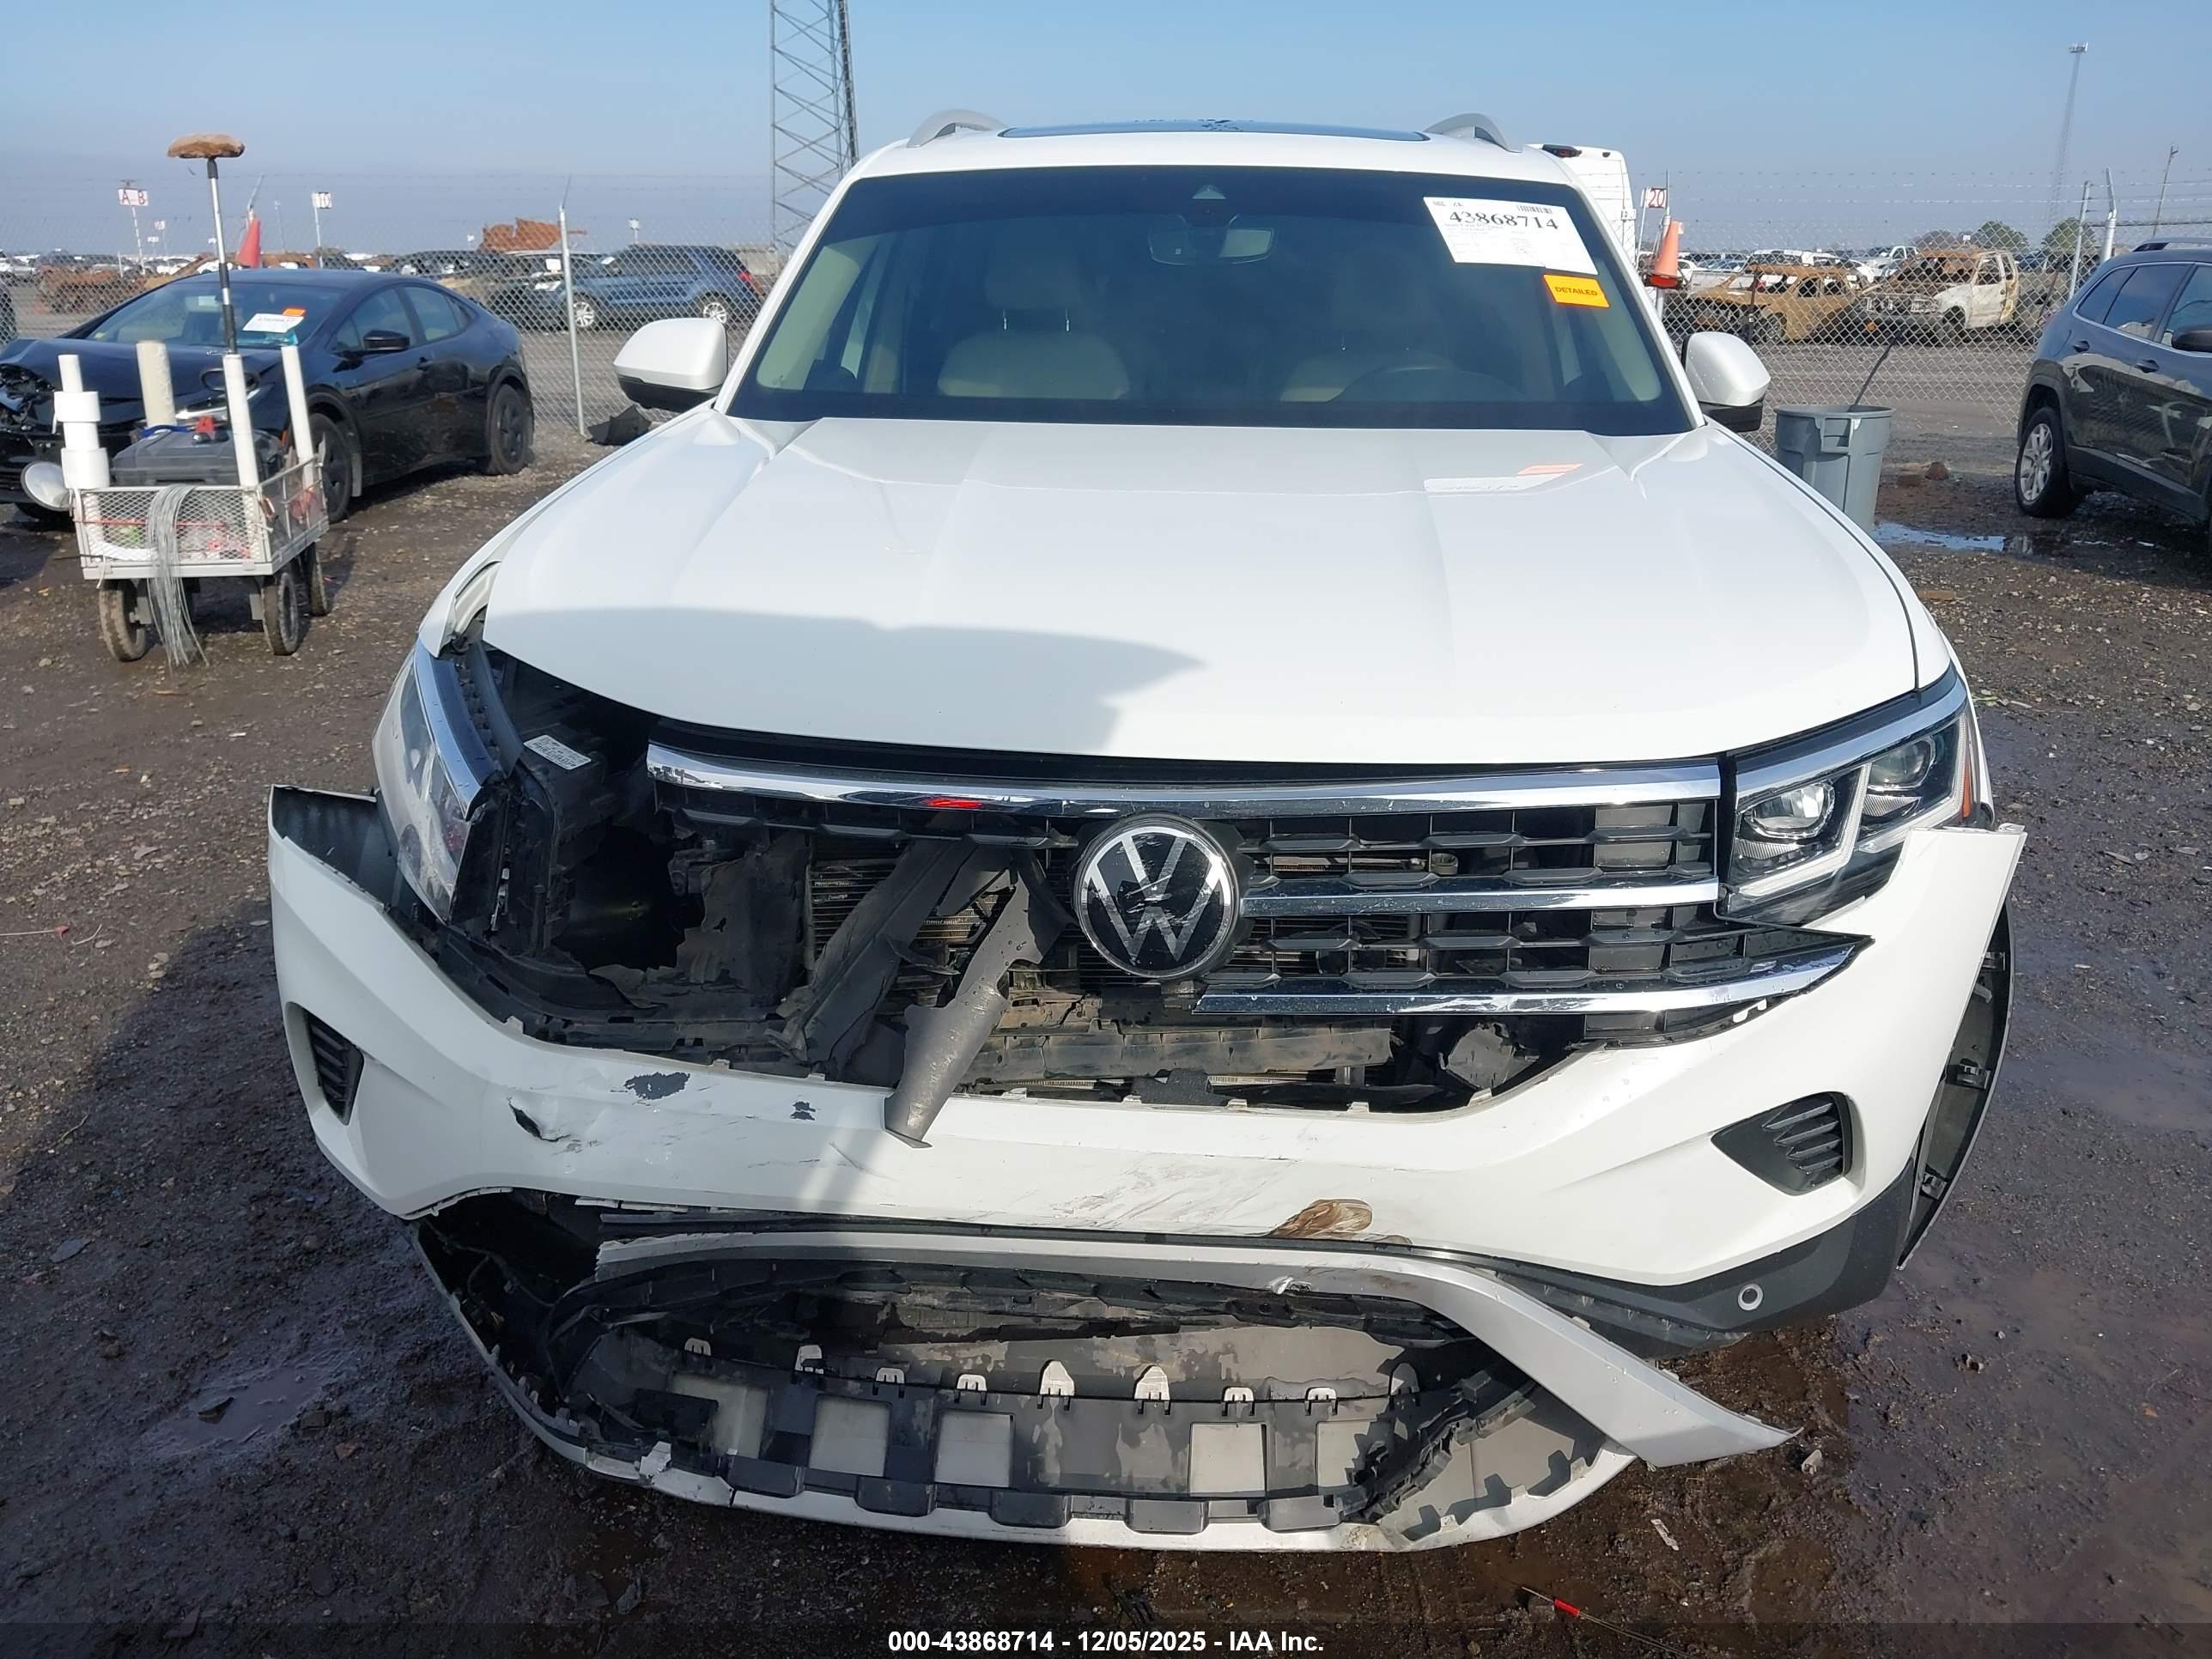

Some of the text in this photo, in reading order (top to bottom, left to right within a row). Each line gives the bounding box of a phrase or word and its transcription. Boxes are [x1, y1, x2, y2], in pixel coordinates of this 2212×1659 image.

[122, 188, 145, 204] A B
[1648, 187, 1666, 208] 20
[1449, 211, 1559, 230] 43868714
[1554, 286, 1598, 297] DETAILED
